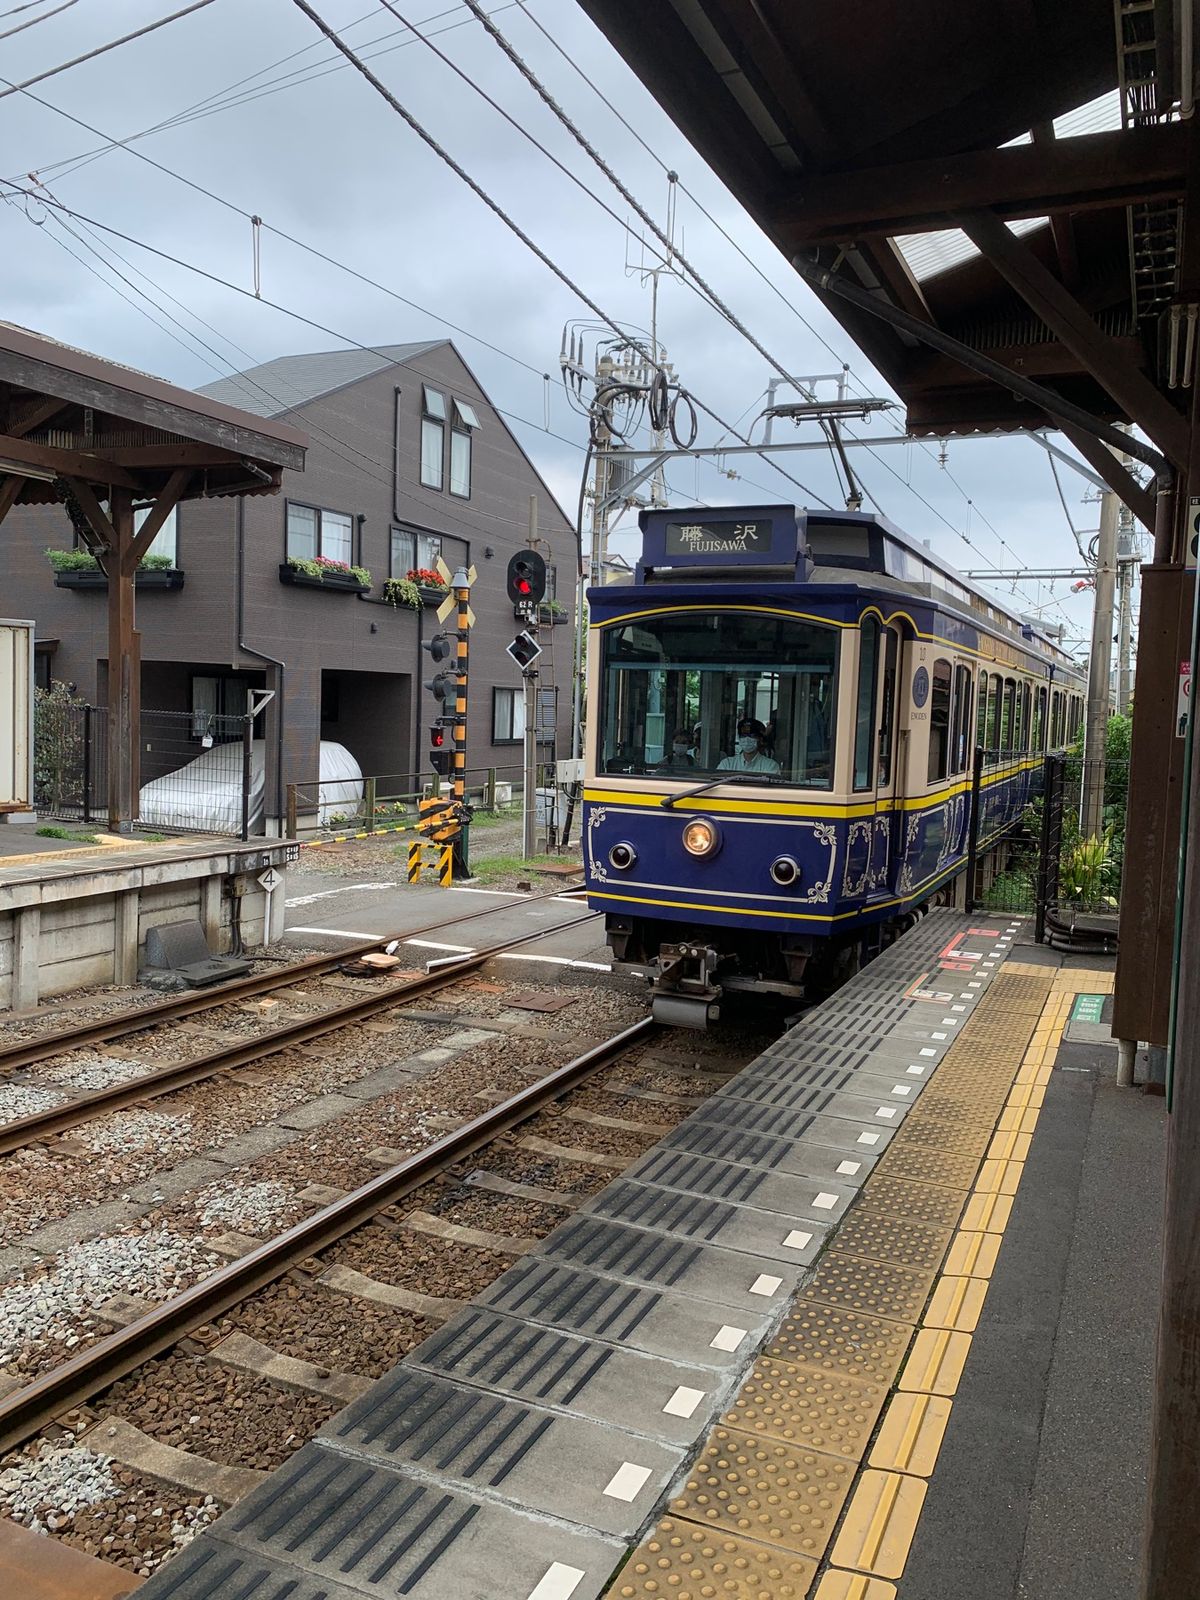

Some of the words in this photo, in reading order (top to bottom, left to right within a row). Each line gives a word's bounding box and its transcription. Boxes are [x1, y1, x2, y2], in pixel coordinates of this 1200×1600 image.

[680, 524, 758, 541] 藤沢
[690, 541, 747, 551] FUJISAWA
[263, 870, 275, 885] 4
